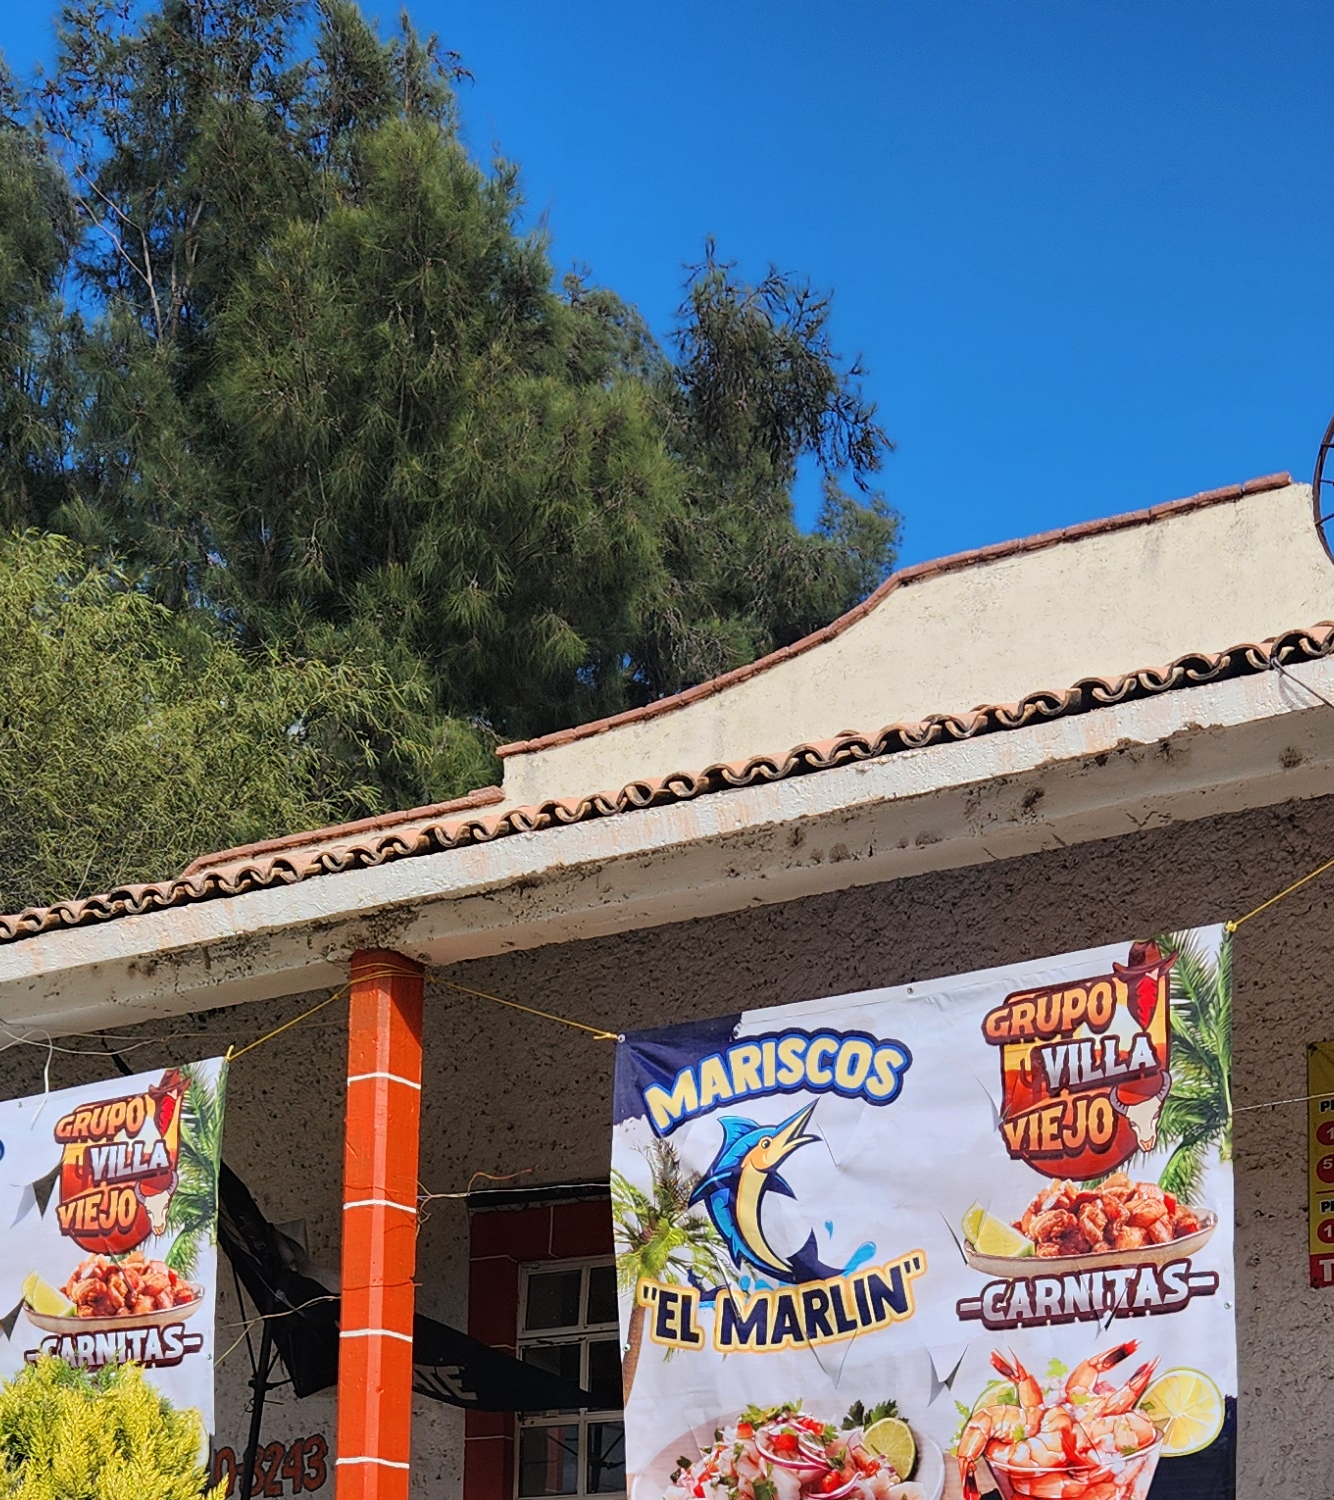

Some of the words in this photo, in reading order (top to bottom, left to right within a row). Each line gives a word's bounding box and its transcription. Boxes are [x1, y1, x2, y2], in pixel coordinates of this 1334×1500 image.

[986, 981, 1113, 1037] GRUPO
[644, 1037, 904, 1129] MARISCOS
[1041, 1036, 1157, 1089] VILLA
[55, 1097, 145, 1137] GRUPO
[1003, 1097, 1114, 1150] VIEJO
[90, 1142, 170, 1181] VILLA
[58, 1188, 137, 1229] VIEJO
[642, 1285, 700, 1343] "EL
[720, 1257, 921, 1345] MARLIN"
